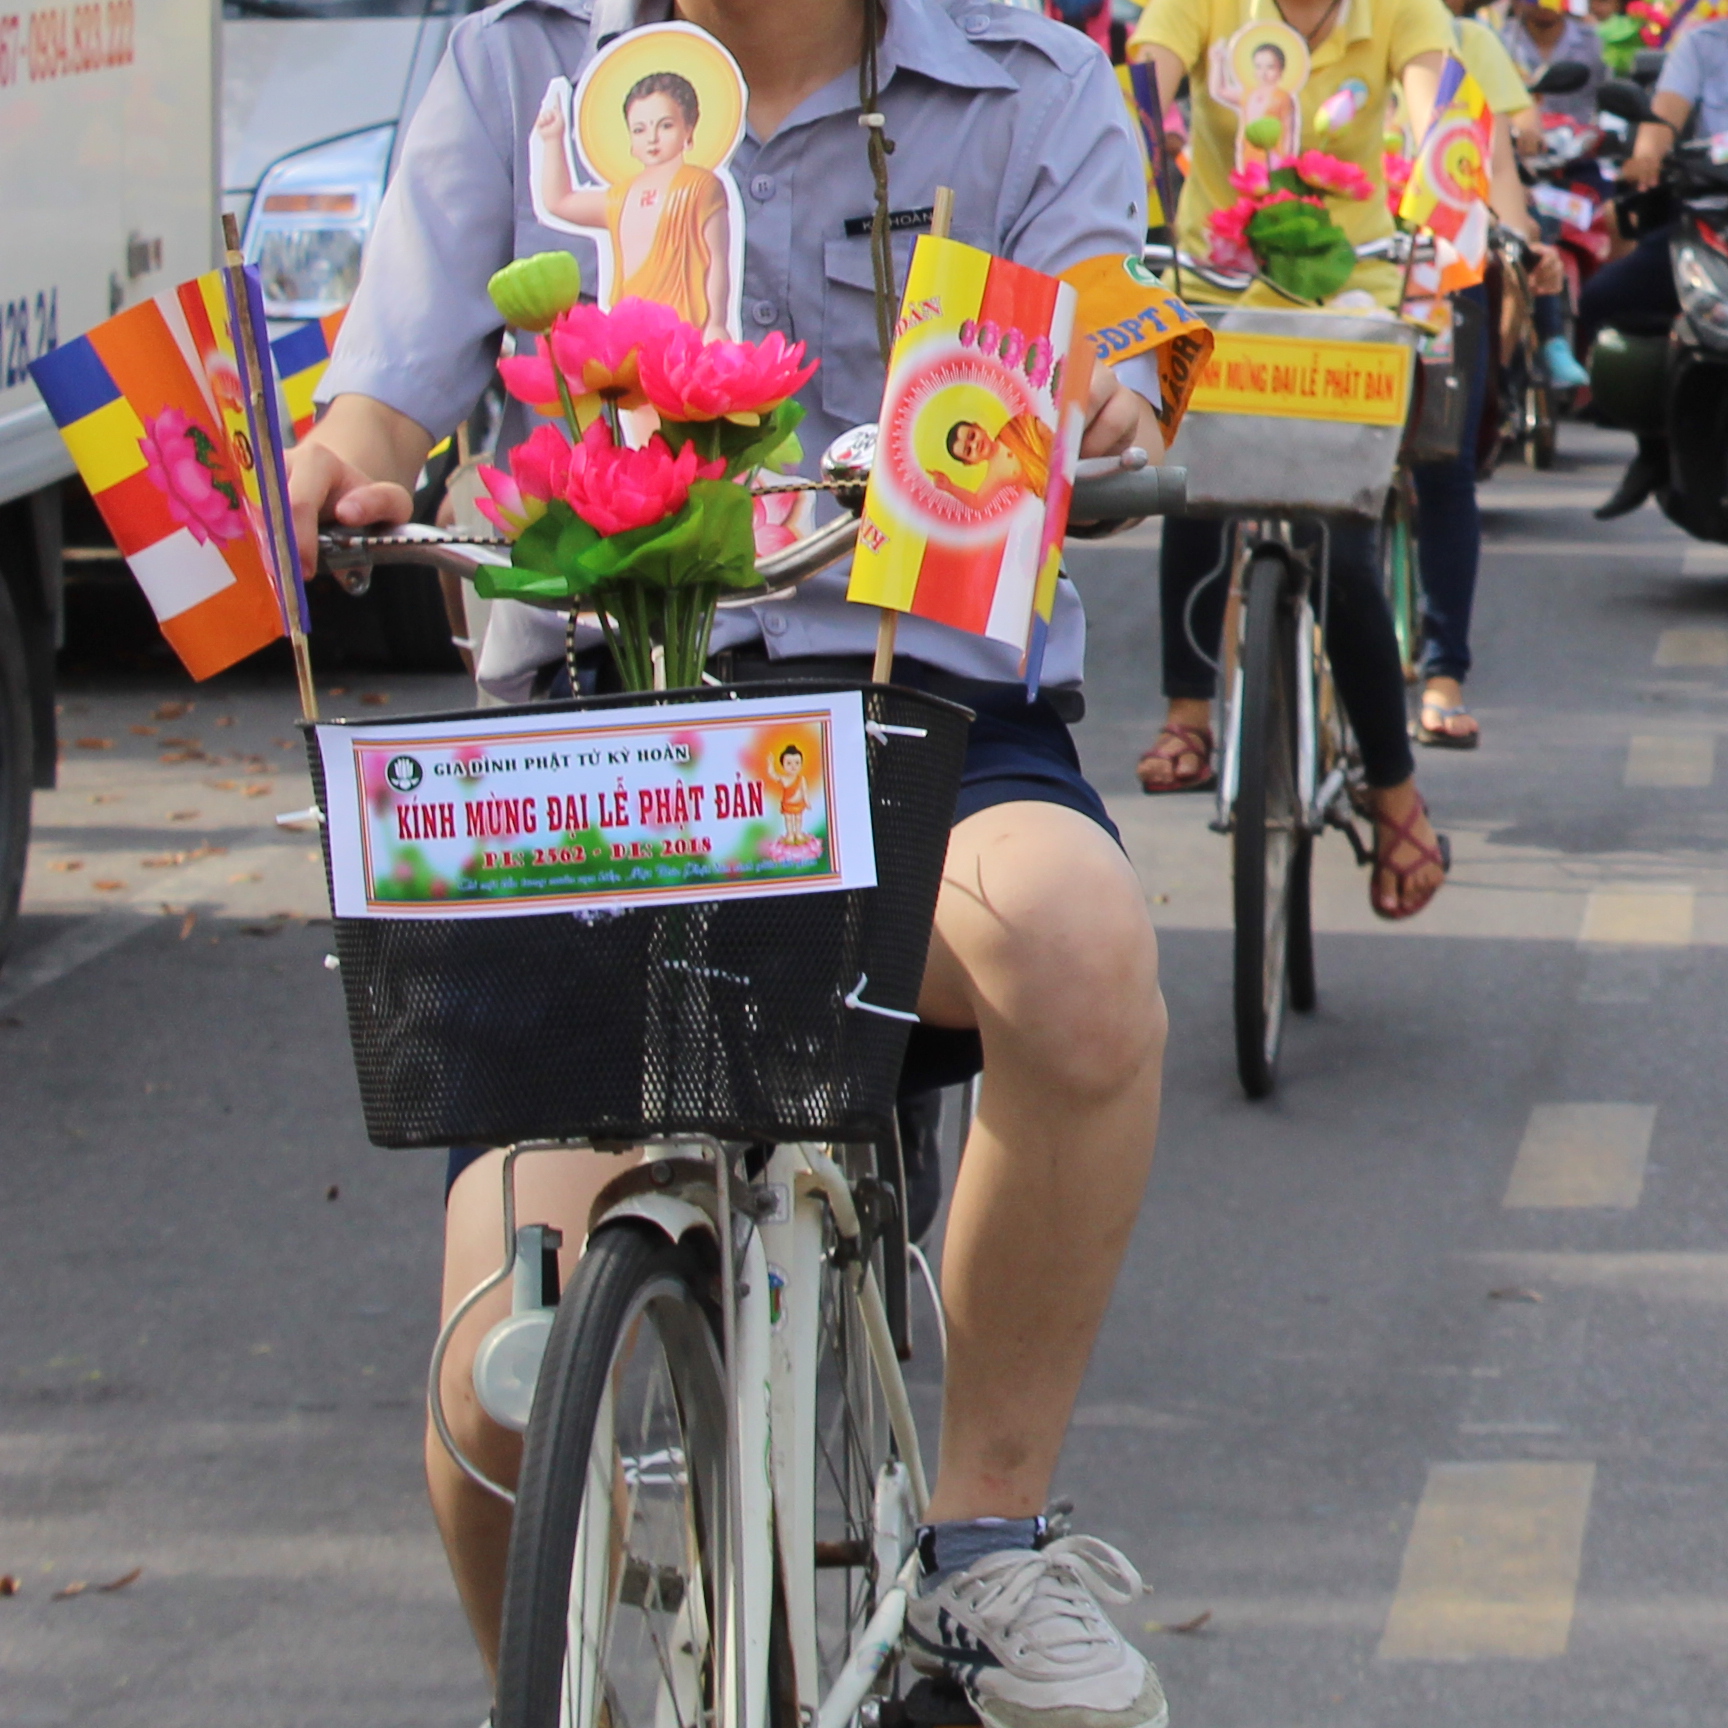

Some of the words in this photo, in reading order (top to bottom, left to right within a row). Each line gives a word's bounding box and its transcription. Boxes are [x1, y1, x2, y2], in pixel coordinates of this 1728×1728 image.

[434, 760, 463, 777] GIA
[524, 752, 571, 772] PHẬT
[637, 742, 689, 763] HOÀN
[397, 795, 456, 841] KÍNH
[546, 793, 589, 839] ĐẠI
[598, 776, 629, 828] LỄ
[639, 778, 704, 831] PHẬT
[714, 771, 764, 820] ĐẢN
[532, 845, 586, 866] 2562
[661, 837, 713, 857] 2018
